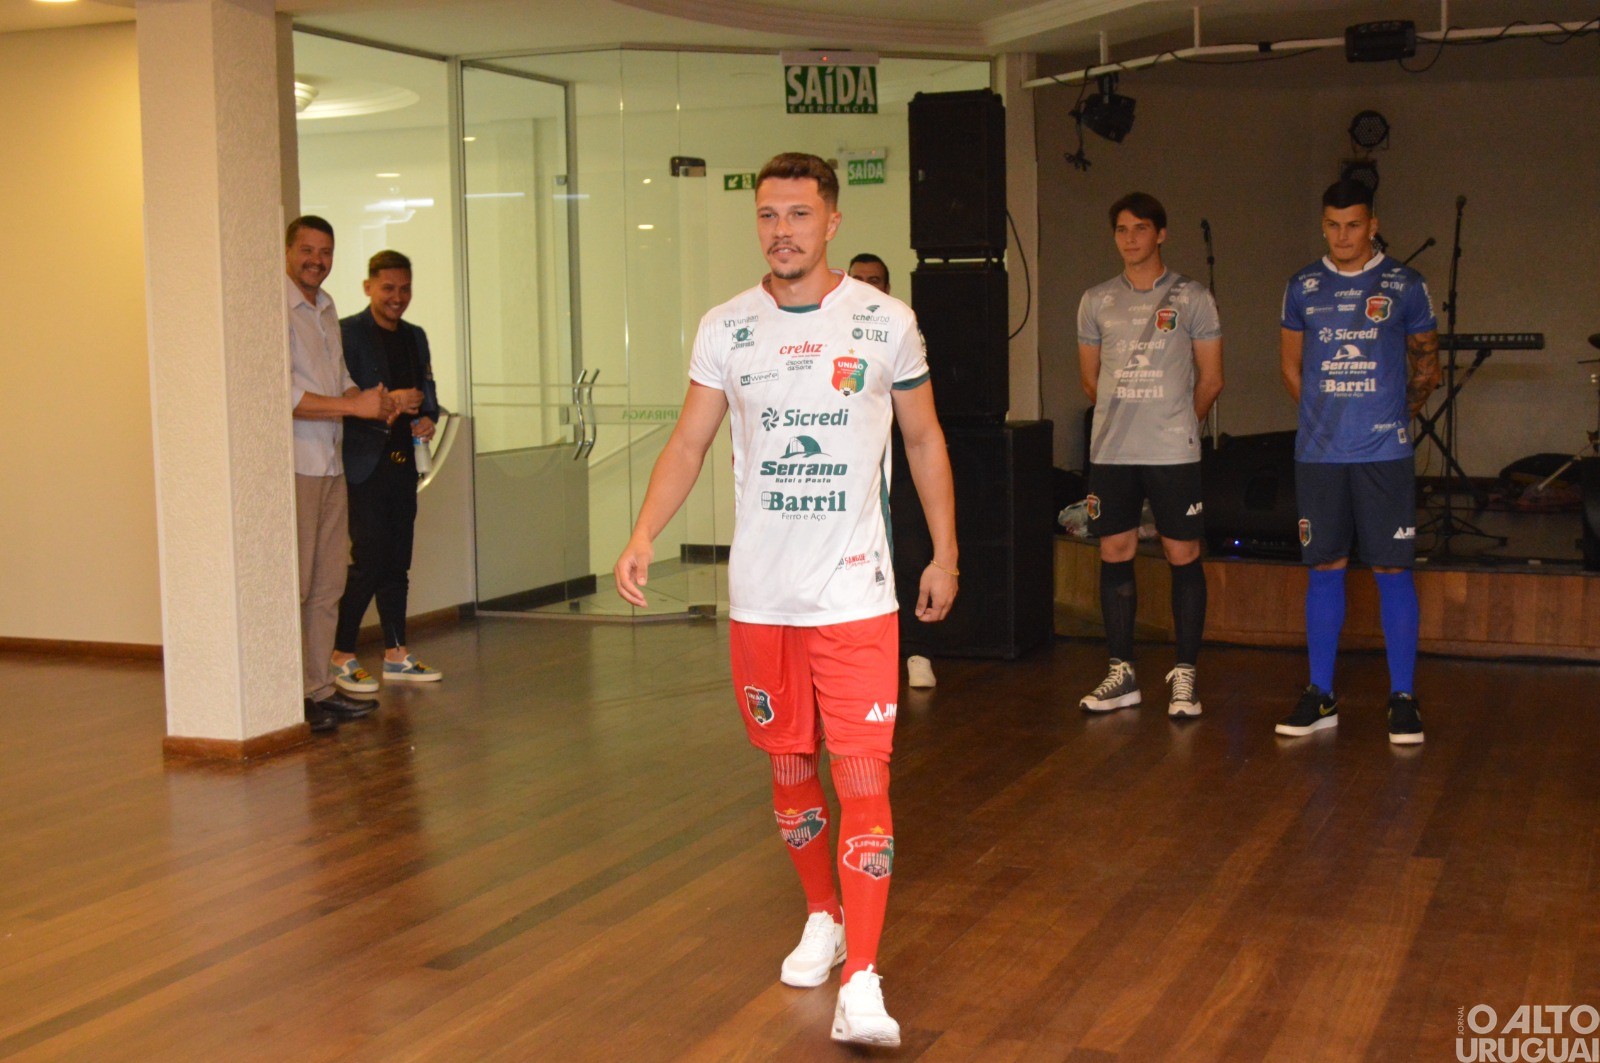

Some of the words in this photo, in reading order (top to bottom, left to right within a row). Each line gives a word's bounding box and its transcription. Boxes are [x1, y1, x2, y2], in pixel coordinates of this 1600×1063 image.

[865, 329, 889, 343] URI
[1334, 328, 1379, 341] Sicredi
[779, 340, 823, 355] creluz
[1129, 339, 1166, 351] Sicredi
[1321, 360, 1378, 371] Serrano
[1117, 385, 1164, 399] Barril
[1325, 378, 1377, 393] Barril
[783, 408, 850, 427] Sicredi
[760, 460, 848, 476] Serrano
[768, 490, 847, 512] Barril
[781, 512, 802, 520] Ferro
[810, 512, 827, 522] Aço
